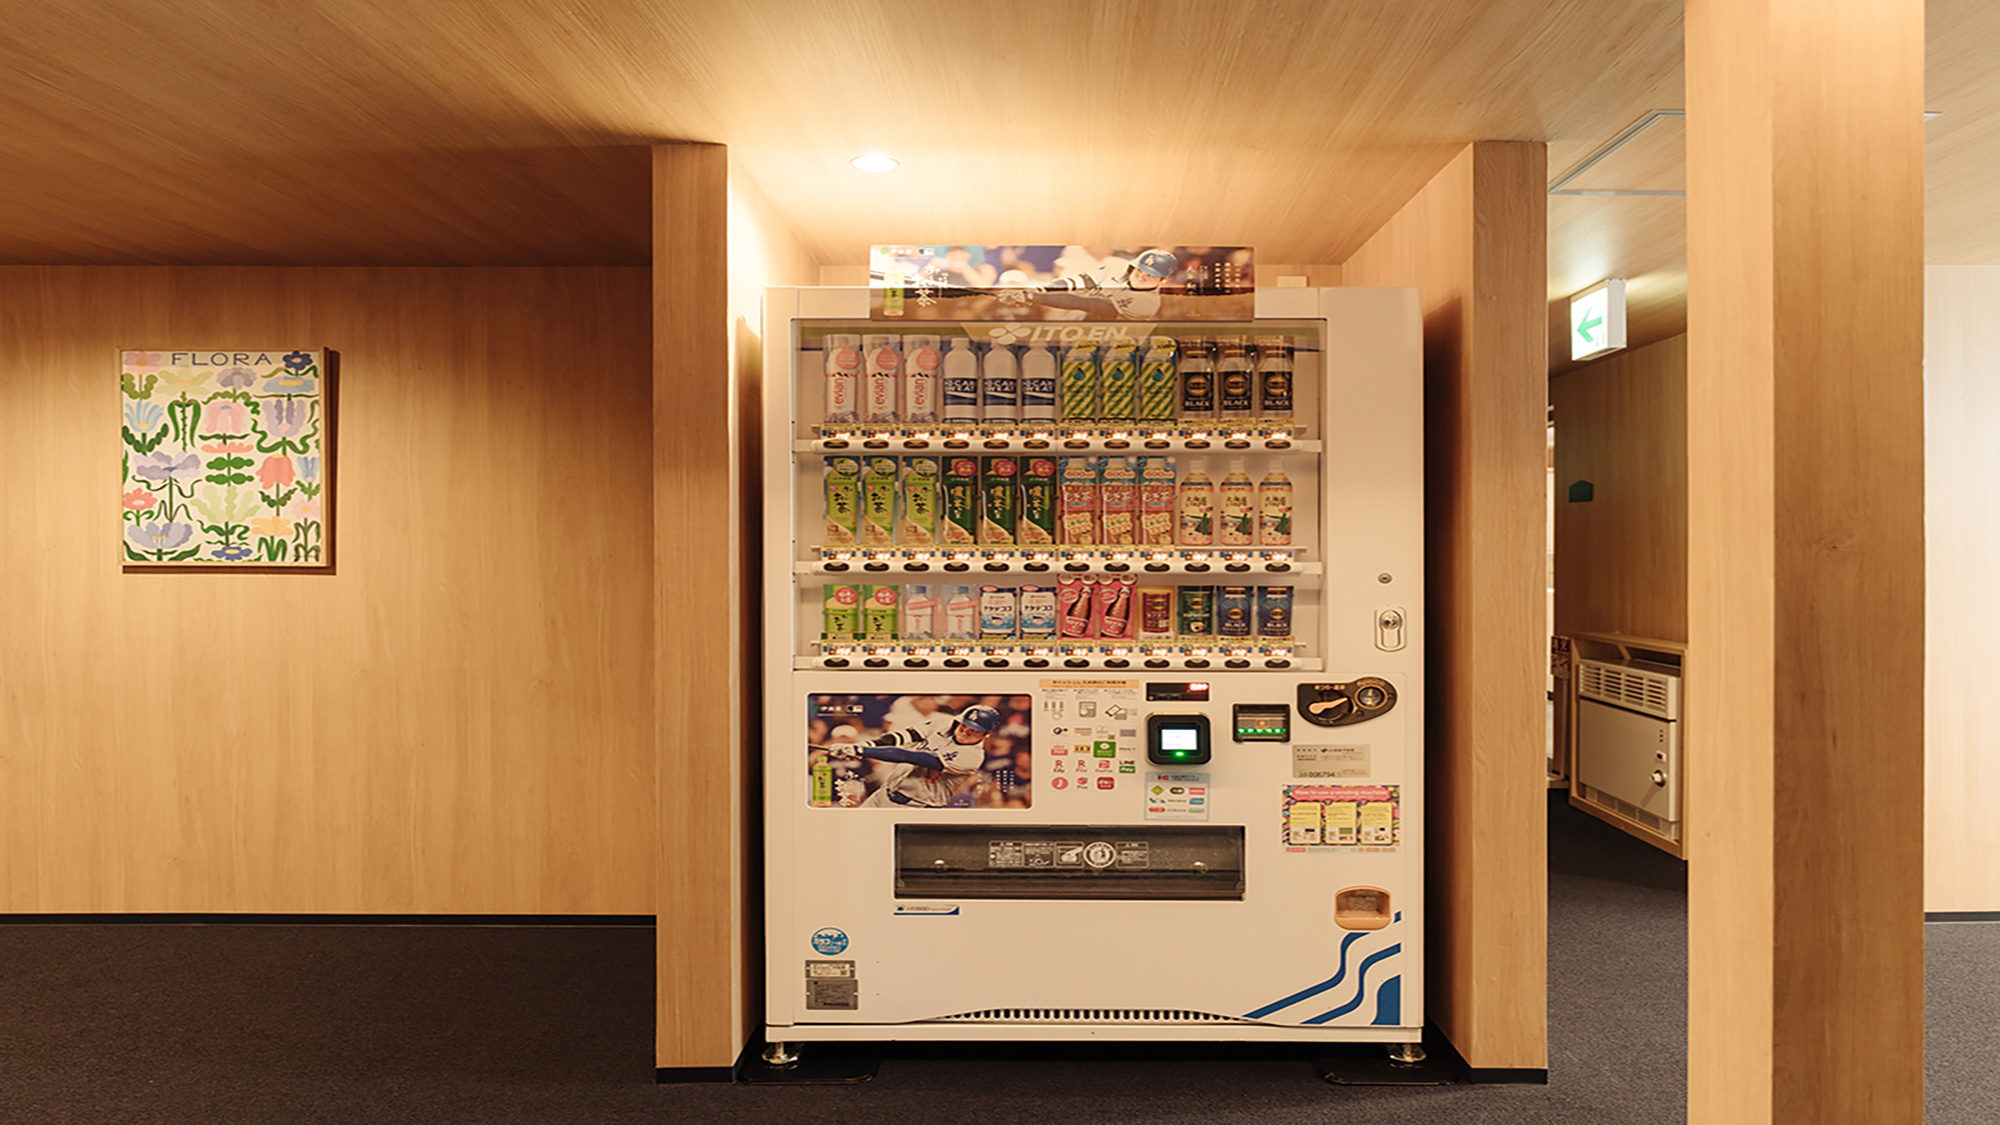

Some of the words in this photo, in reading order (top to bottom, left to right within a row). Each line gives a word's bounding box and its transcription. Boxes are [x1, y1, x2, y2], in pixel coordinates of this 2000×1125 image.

[1030, 326, 1084, 342] ITO
[1086, 326, 1128, 342] EN
[172, 352, 272, 366] FLORA
[834, 378, 844, 405] evian
[874, 378, 886, 405] evian
[914, 378, 925, 405] evian
